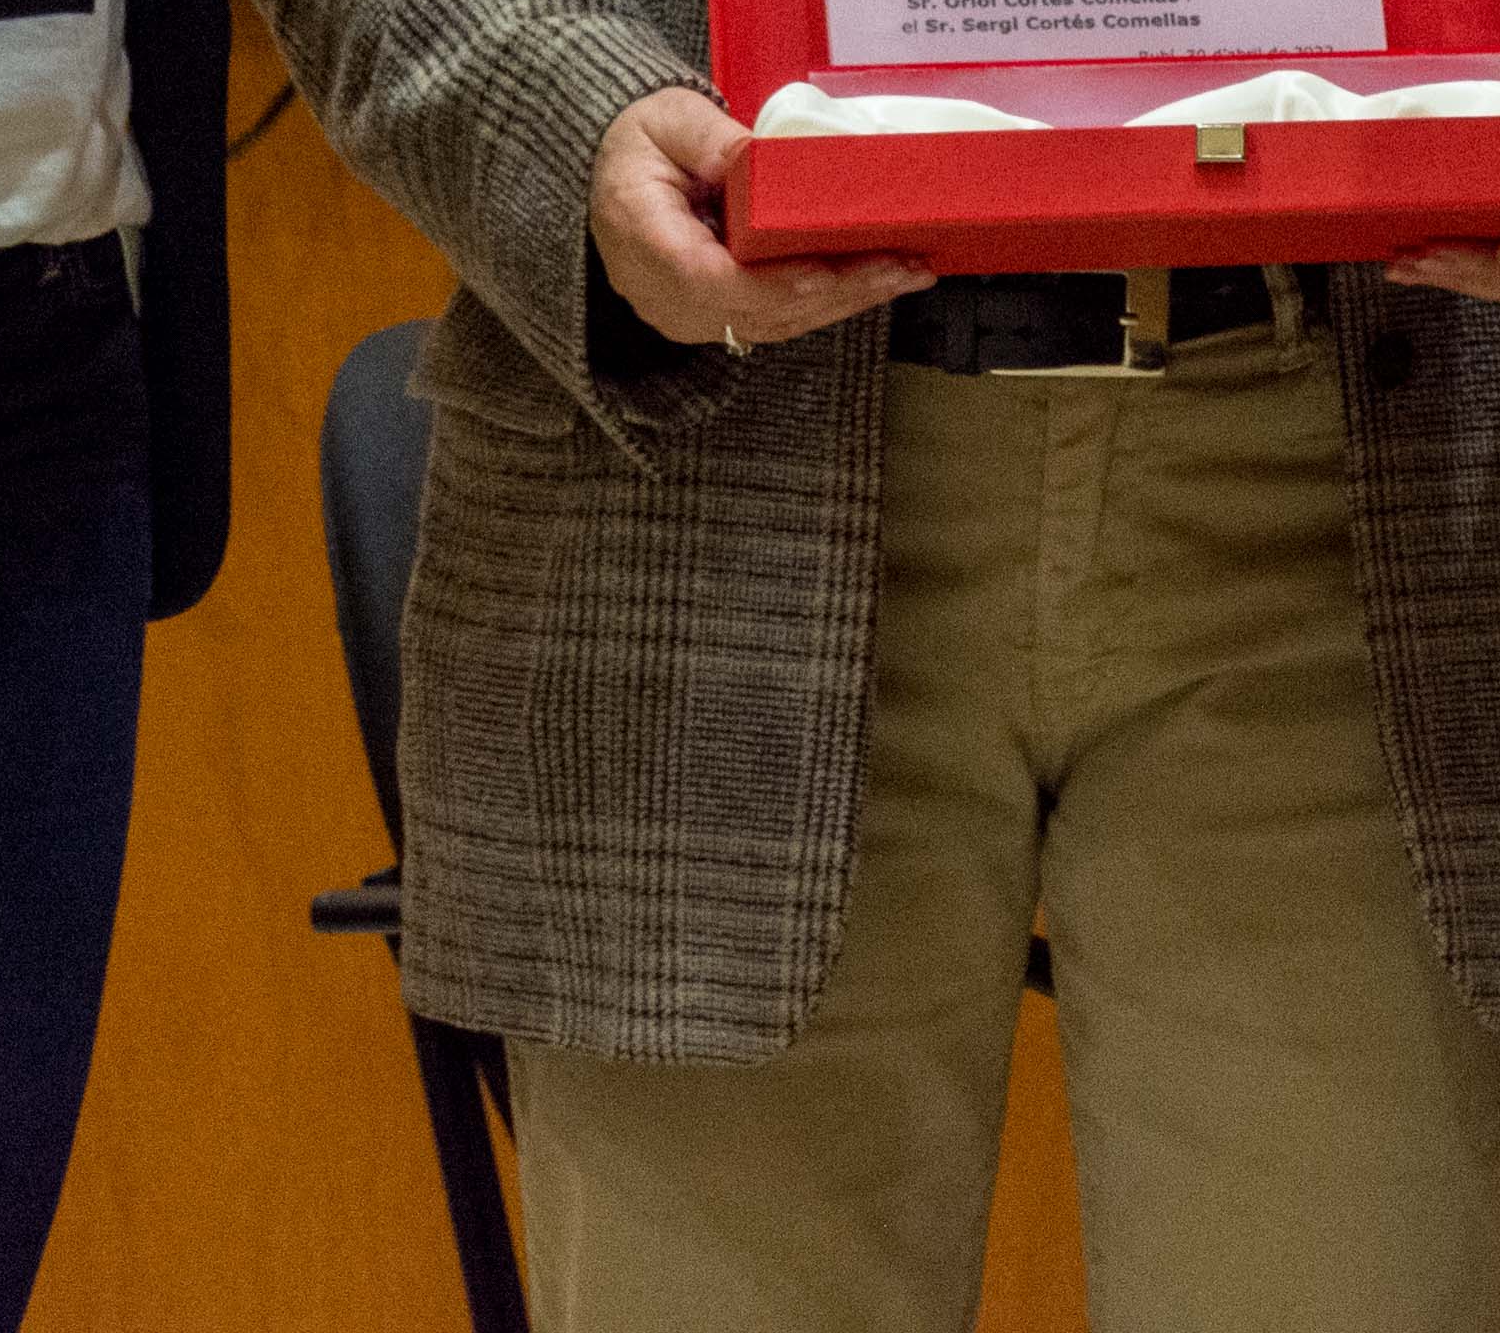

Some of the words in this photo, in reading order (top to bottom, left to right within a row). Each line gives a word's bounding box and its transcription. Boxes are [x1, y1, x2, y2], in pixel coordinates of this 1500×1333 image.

[901, 19, 918, 35] el
[924, 18, 957, 34] Sr.
[961, 15, 1020, 36] Sergi
[1024, 13, 1096, 32] Cortés
[1101, 12, 1202, 30] Comellas
